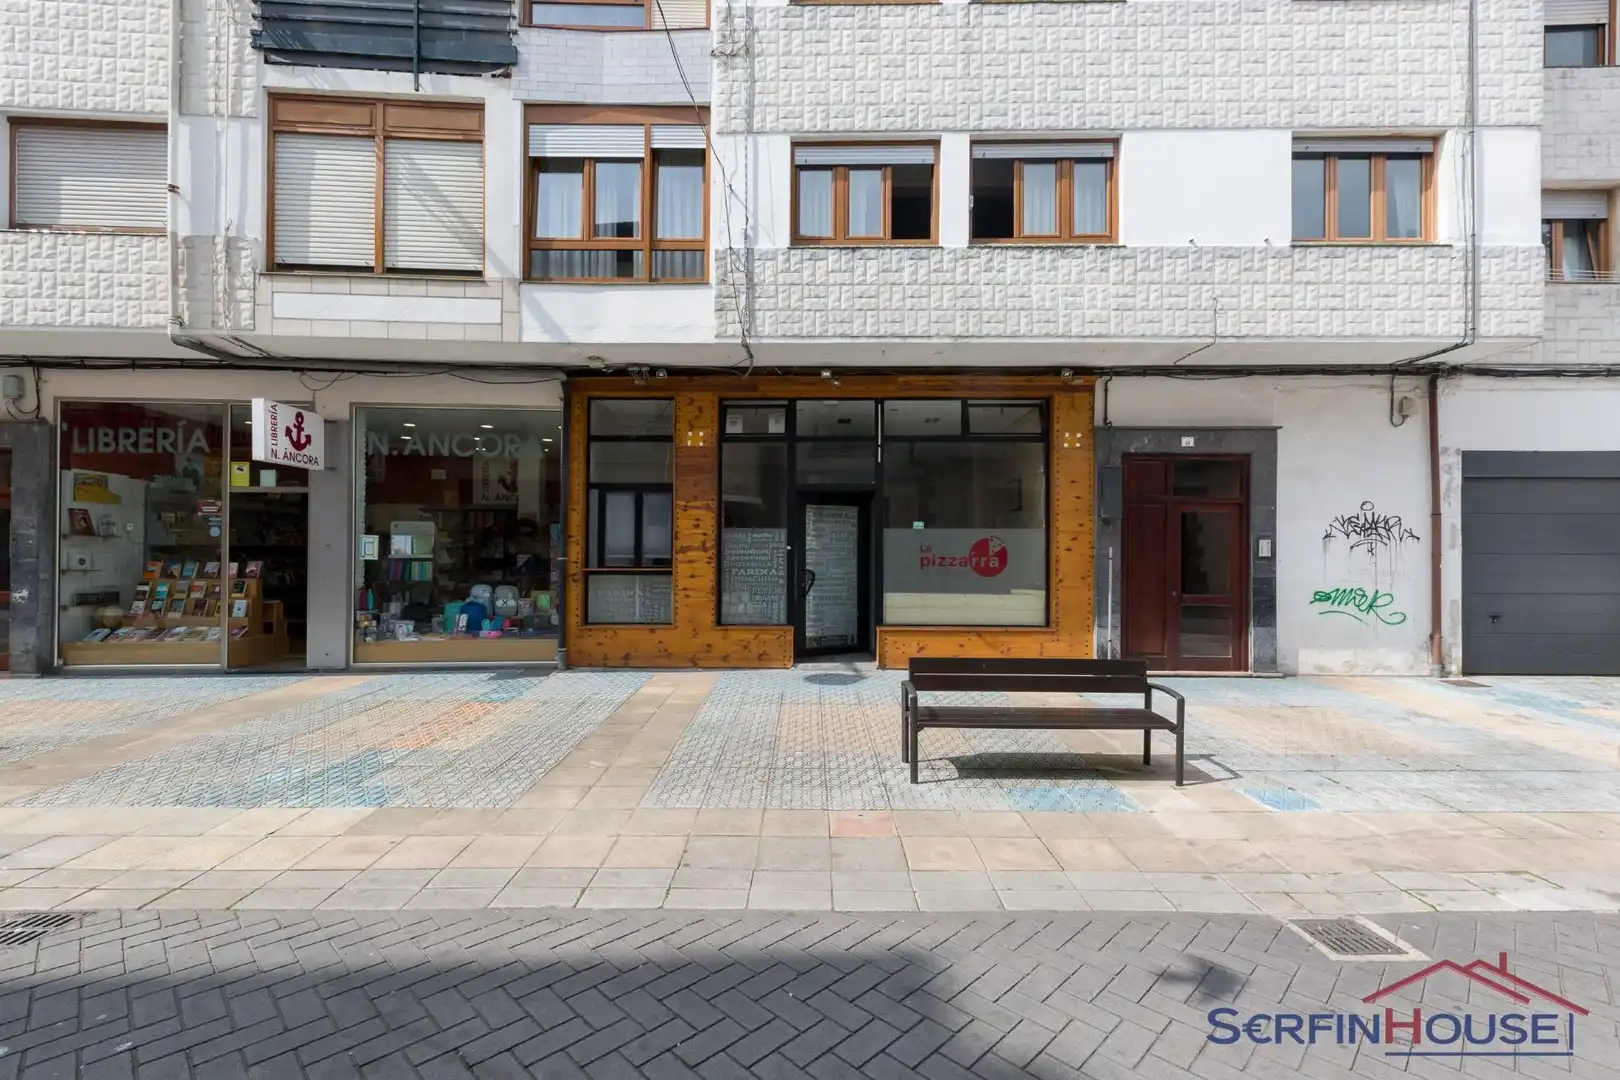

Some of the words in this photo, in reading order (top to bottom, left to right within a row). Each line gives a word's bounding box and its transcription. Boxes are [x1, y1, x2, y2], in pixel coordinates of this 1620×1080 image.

[72, 420, 211, 453] LIBRERÍA
[268, 404, 278, 446] LIBRERÍA
[731, 568, 778, 576] FARINA
[919, 552, 1000, 570] pizzarra
